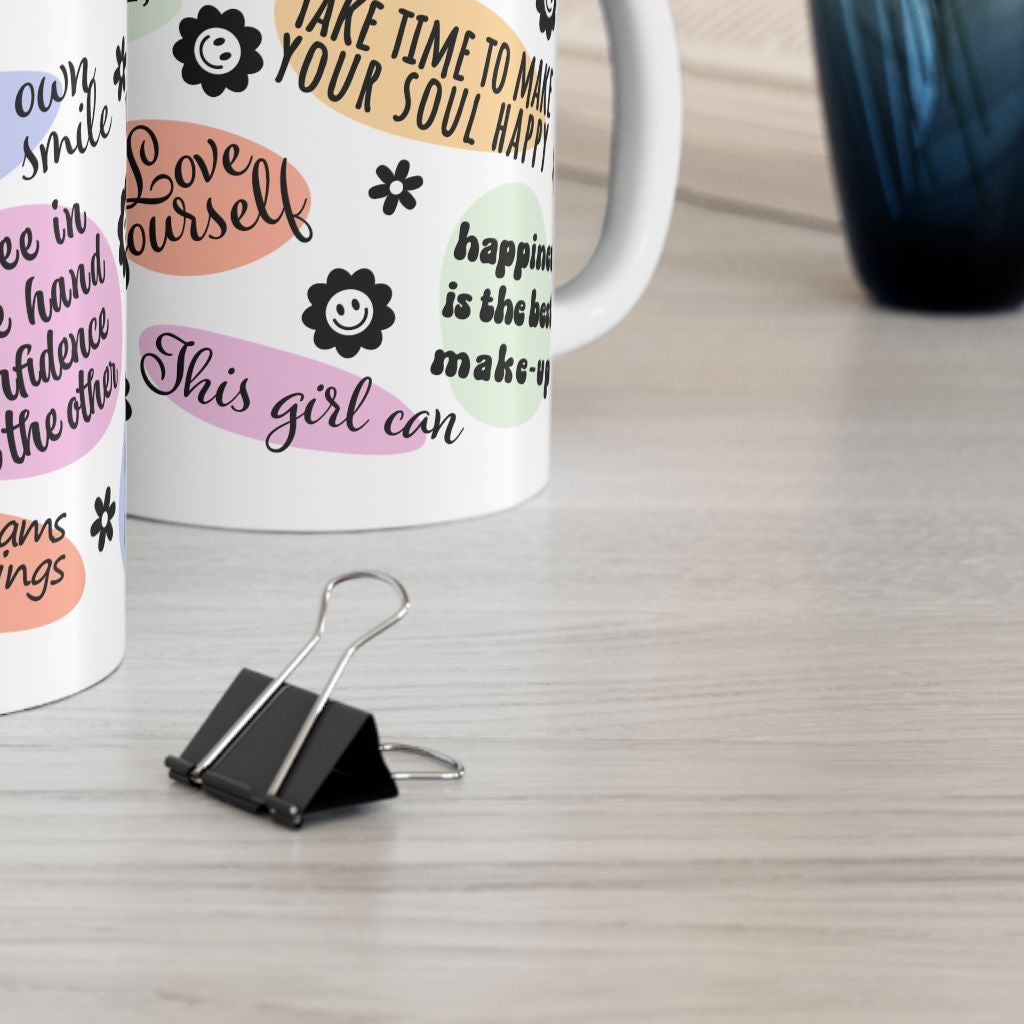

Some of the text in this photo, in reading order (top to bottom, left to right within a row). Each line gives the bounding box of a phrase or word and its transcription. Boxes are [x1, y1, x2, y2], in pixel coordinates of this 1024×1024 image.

[14, 57, 97, 117] own
[391, 8, 476, 82] TIME
[480, 36, 511, 94] TO
[21, 78, 112, 180] smile
[275, 32, 549, 172] YOUR SOUL HAPPY
[126, 125, 253, 209] Love
[126, 157, 314, 257] ourself
[52, 199, 86, 244] in
[25, 233, 105, 325] hand
[442, 281, 473, 320] is
[479, 285, 526, 326] the
[1, 408, 63, 464] the
[67, 361, 118, 429] other
[140, 332, 464, 453] This girl can
[430, 343, 550, 399] make-up
